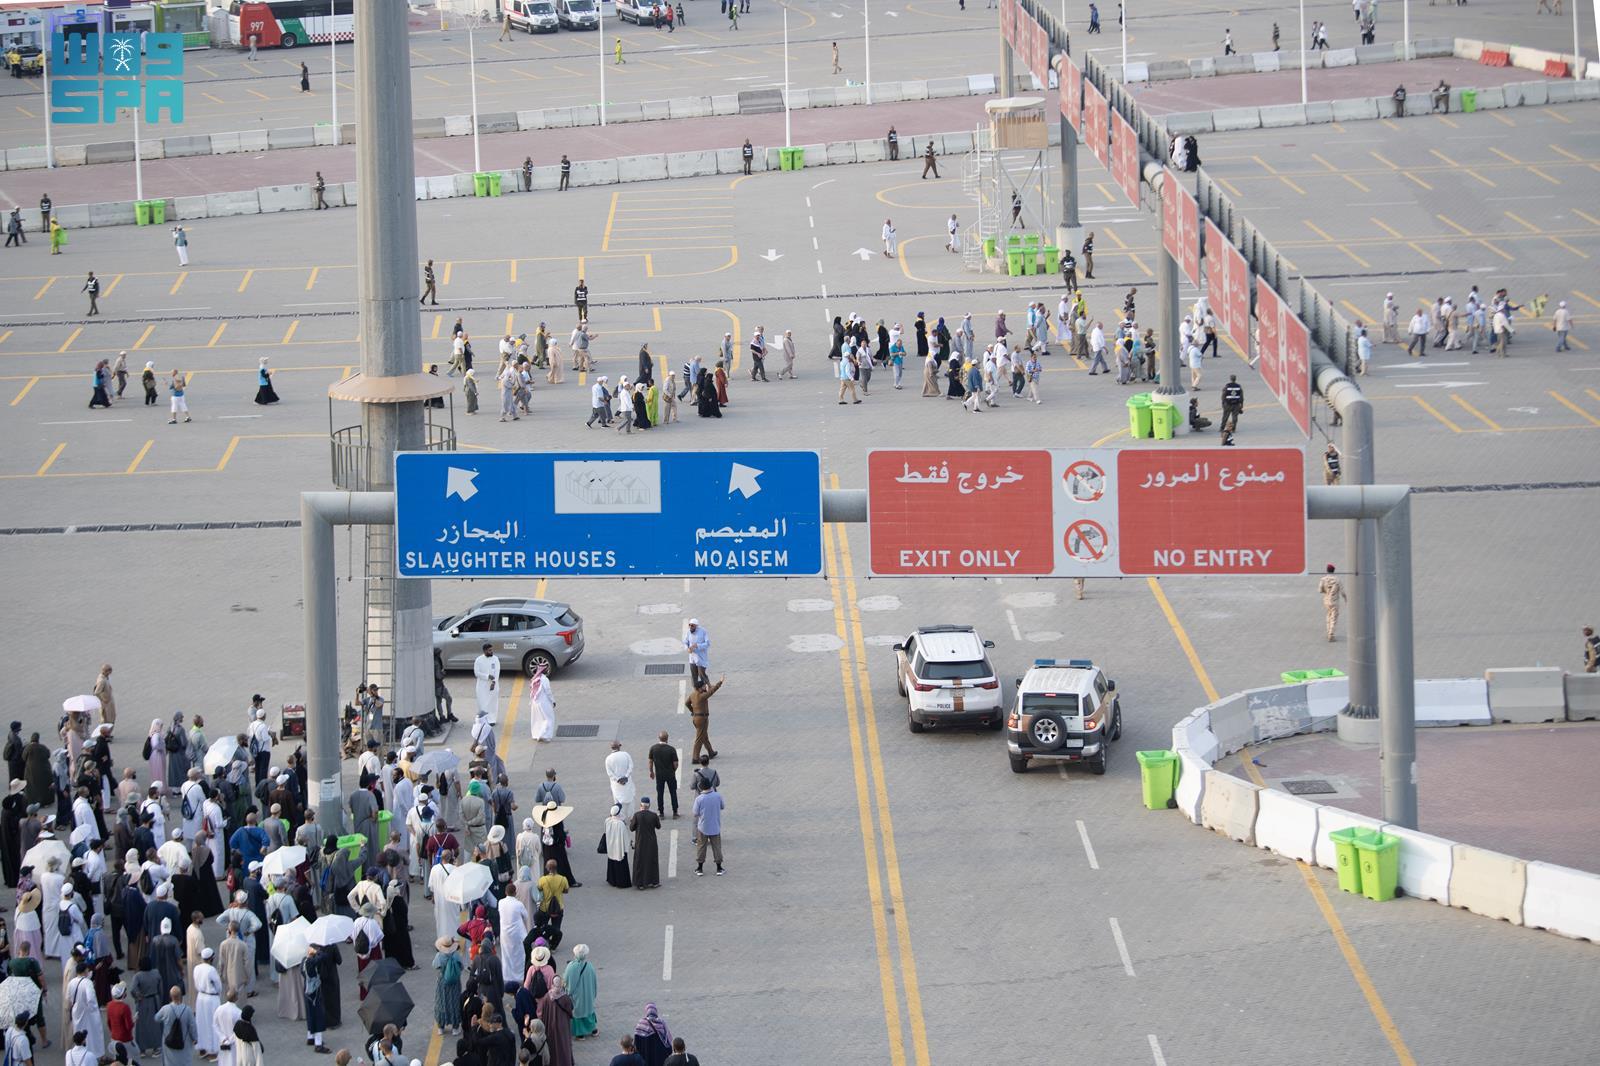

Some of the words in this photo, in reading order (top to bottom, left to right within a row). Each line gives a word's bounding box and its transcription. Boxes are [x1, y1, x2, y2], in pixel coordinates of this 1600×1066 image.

[250, 21, 265, 32] 997
[895, 460, 950, 485] فقط
[958, 465, 1024, 495] خروج
[1140, 462, 1209, 489] المرور
[1219, 464, 1286, 492] ممنوع
[436, 520, 519, 545] المجازر
[694, 517, 787, 544] المعيصم
[405, 551, 526, 569] SLAUGHTER
[535, 550, 616, 568] HOUSES
[694, 550, 788, 568] MOAISEM
[899, 549, 951, 568] EXIT
[959, 549, 1021, 568] ONLY
[1153, 549, 1186, 567] NO
[1194, 549, 1273, 567] ENTRY
